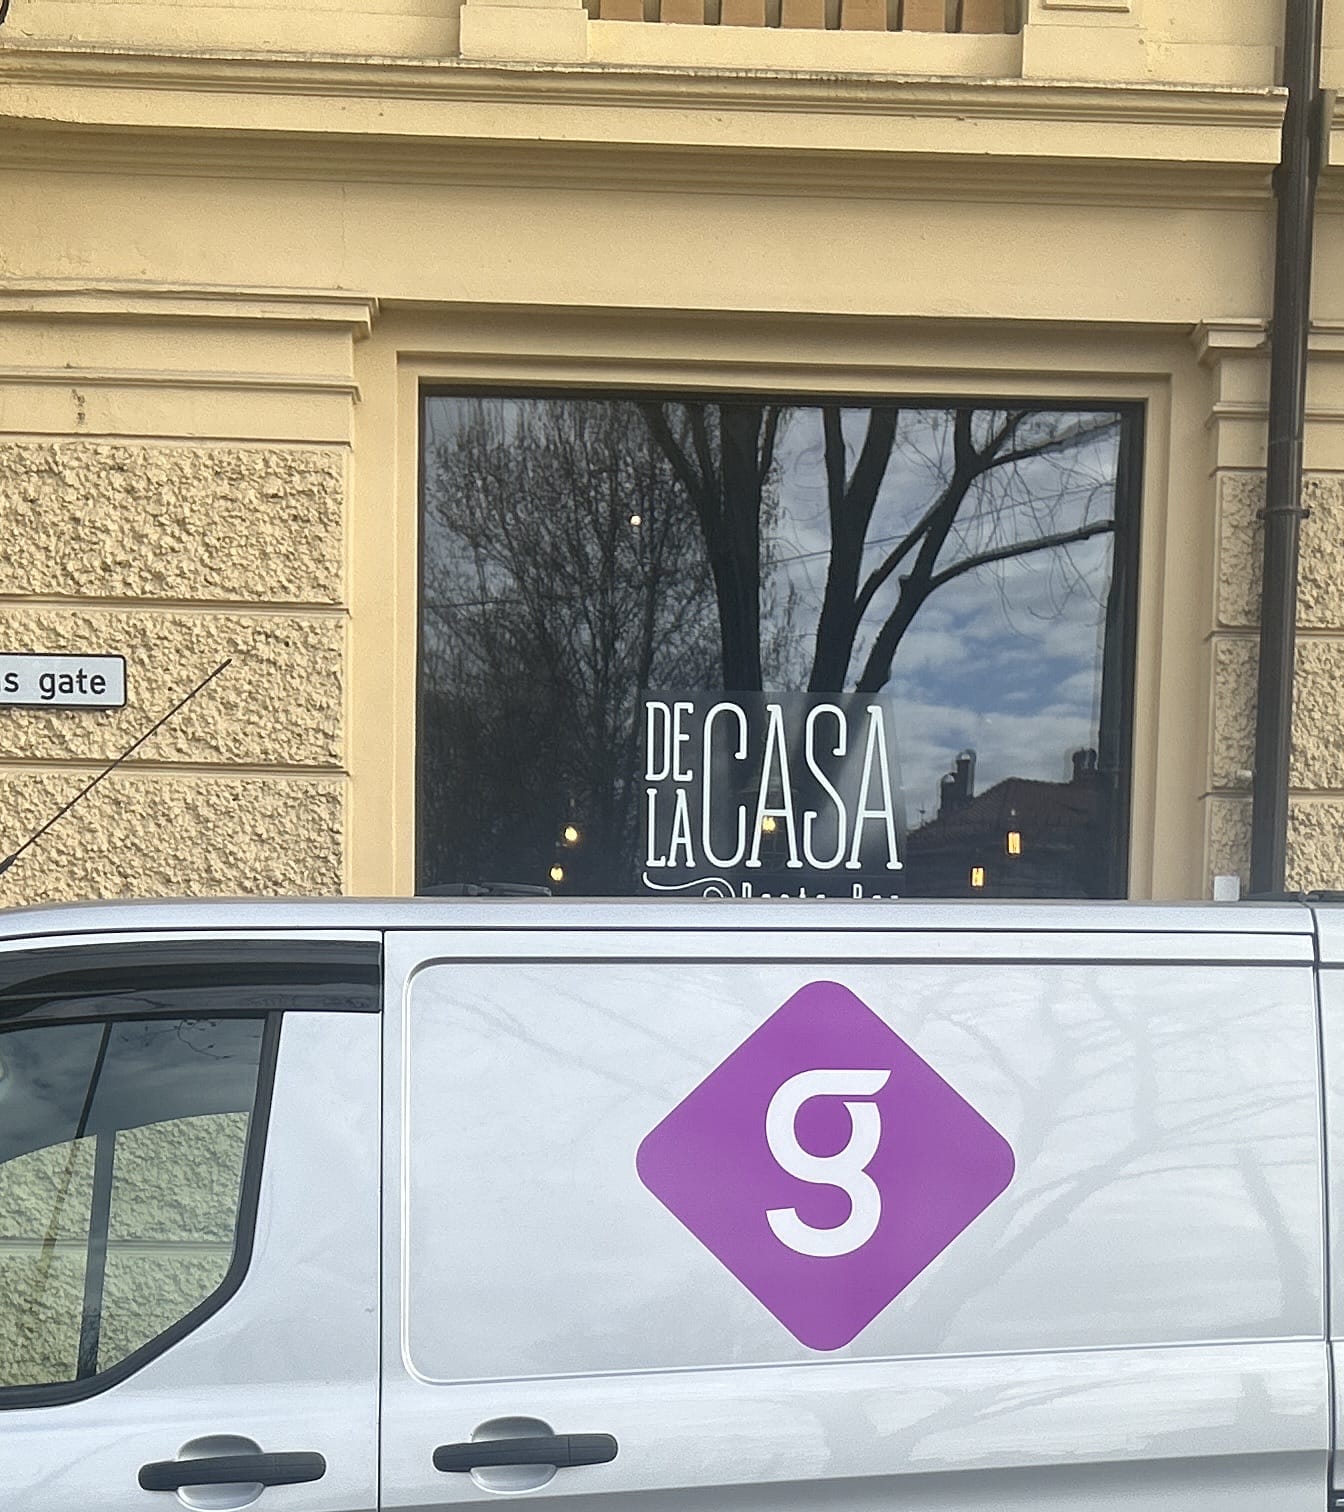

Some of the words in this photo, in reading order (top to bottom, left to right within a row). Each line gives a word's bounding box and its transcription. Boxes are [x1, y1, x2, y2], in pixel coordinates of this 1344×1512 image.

[39, 668, 107, 700] gate
[645, 701, 694, 782] DE
[702, 702, 904, 869] CASA
[646, 788, 696, 867] LA
